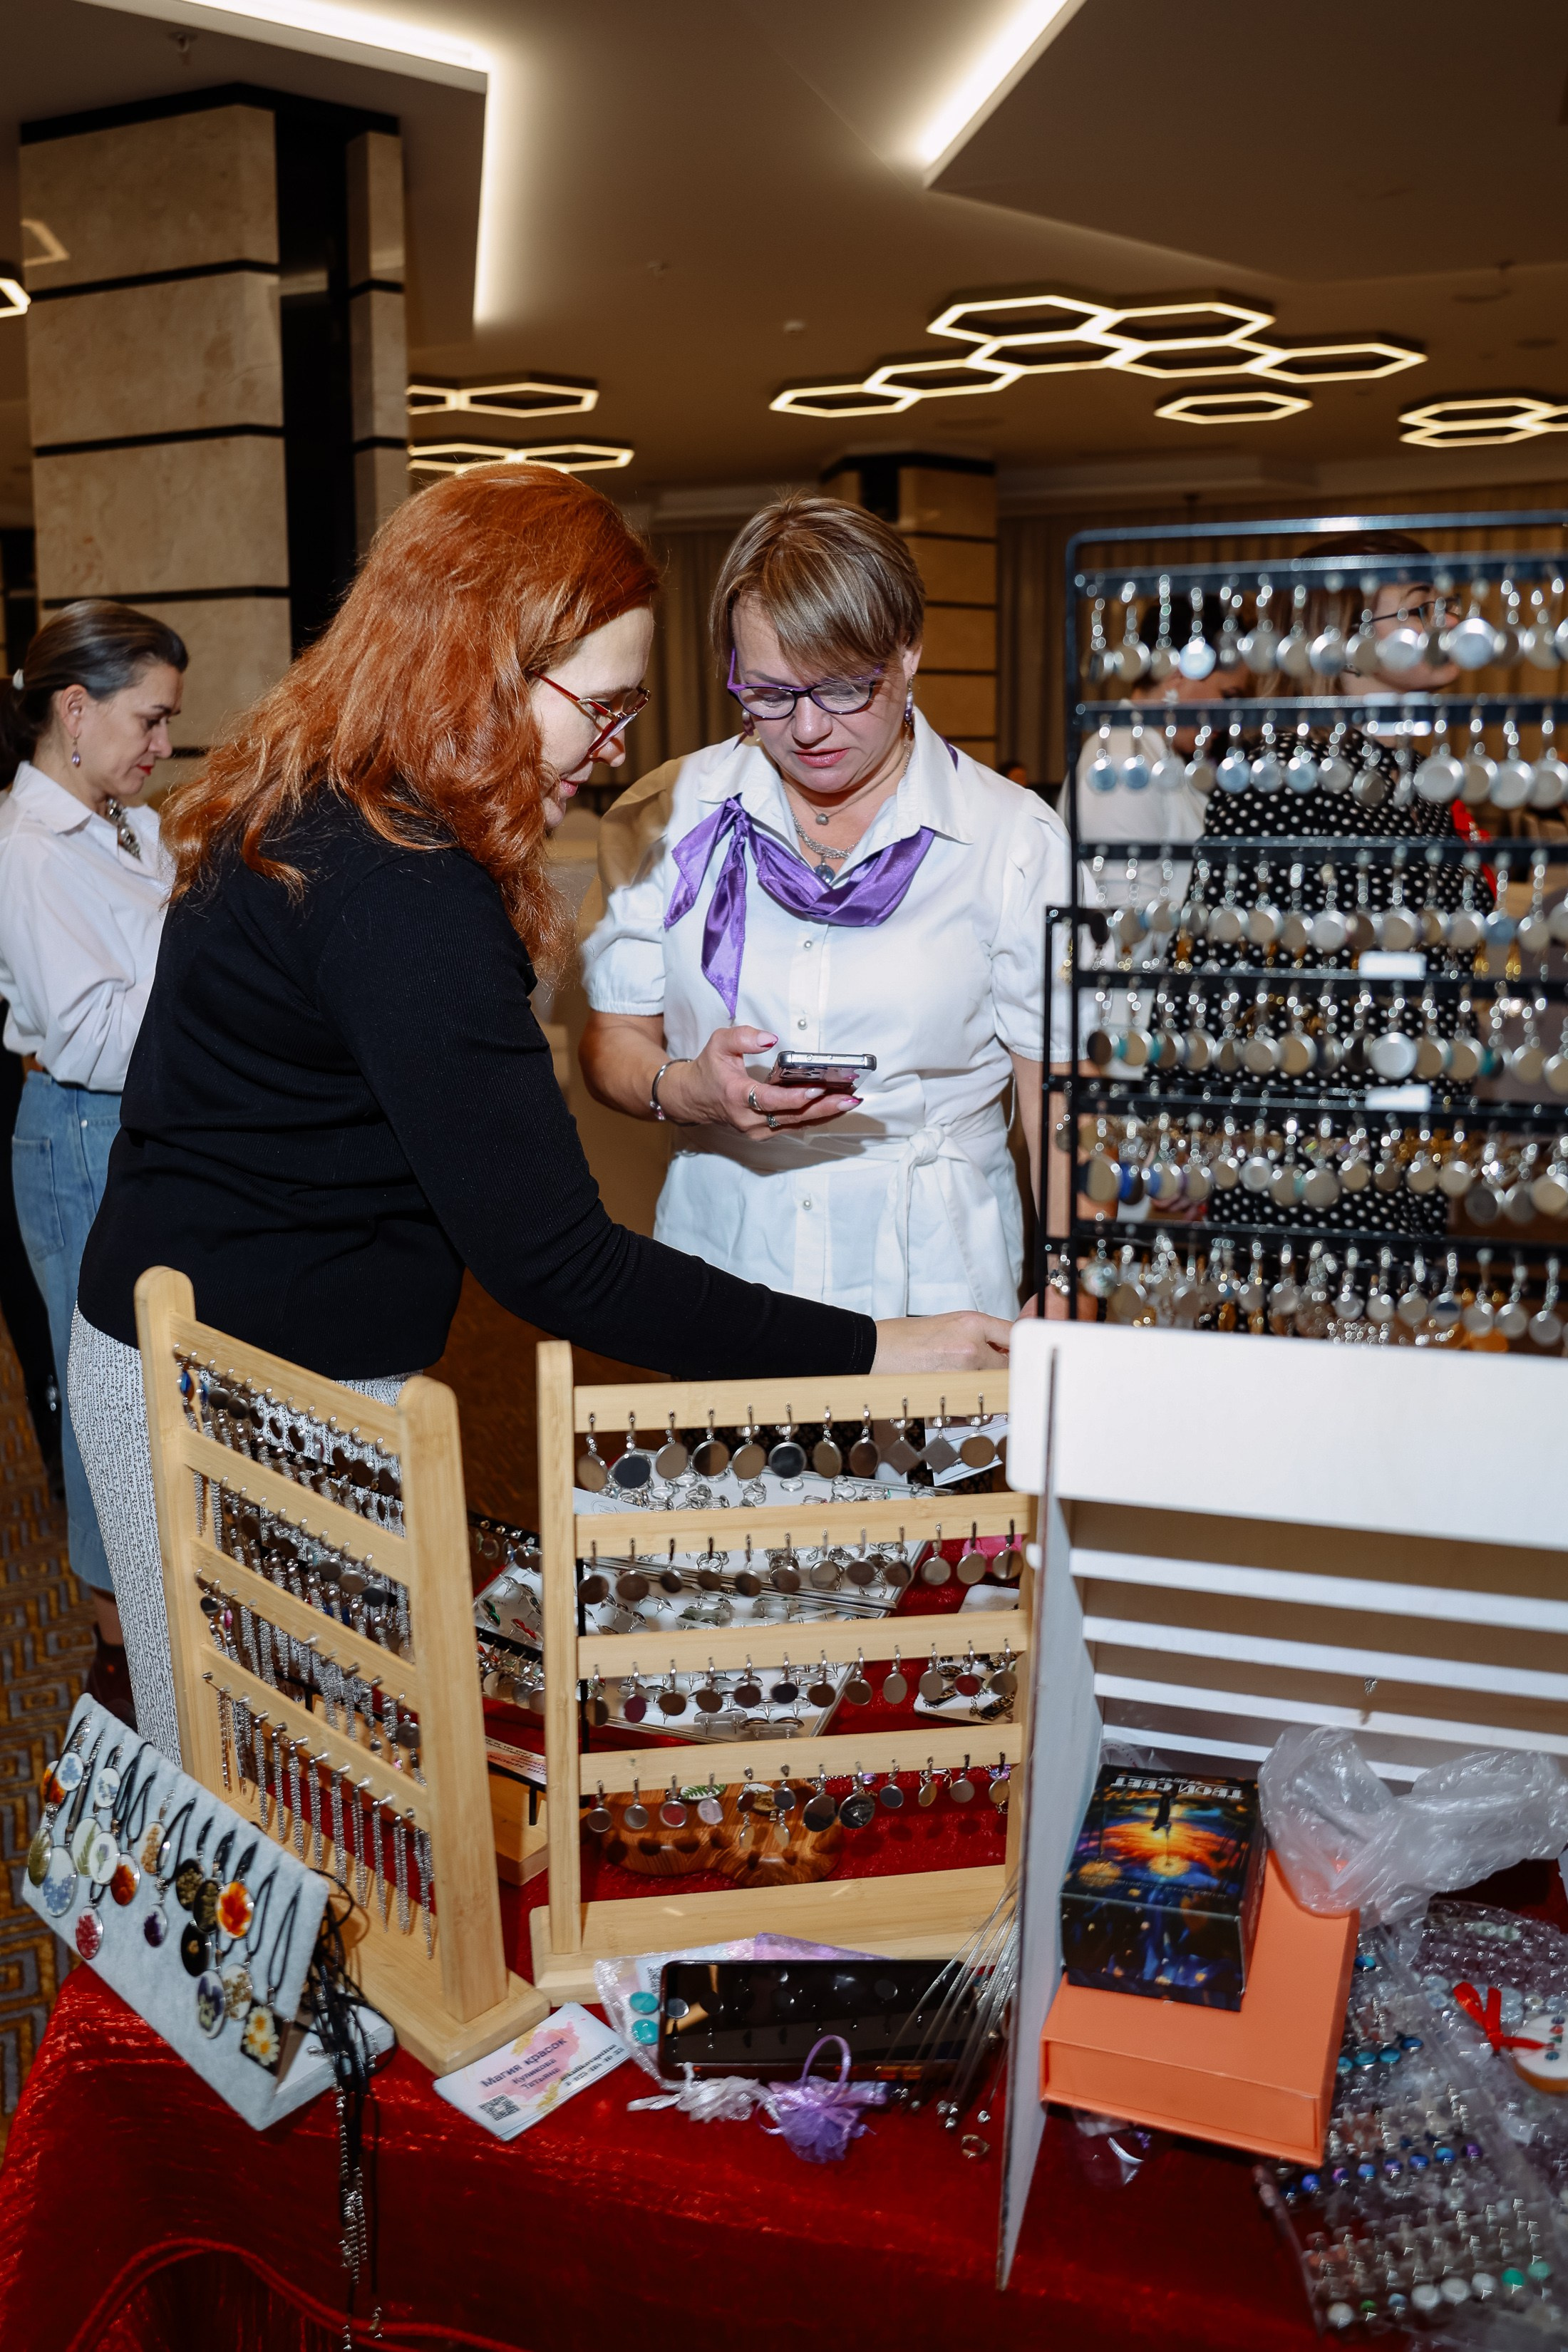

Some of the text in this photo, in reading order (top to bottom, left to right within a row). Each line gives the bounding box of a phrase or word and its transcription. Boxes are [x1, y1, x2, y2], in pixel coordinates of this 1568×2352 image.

[1110, 1777, 1245, 1801] ТВОЙ СВЕТ
[480, 2038, 567, 2087] Магия красок
[512, 2058, 557, 2084] Куликова
[520, 2067, 561, 2089] Татьяна
